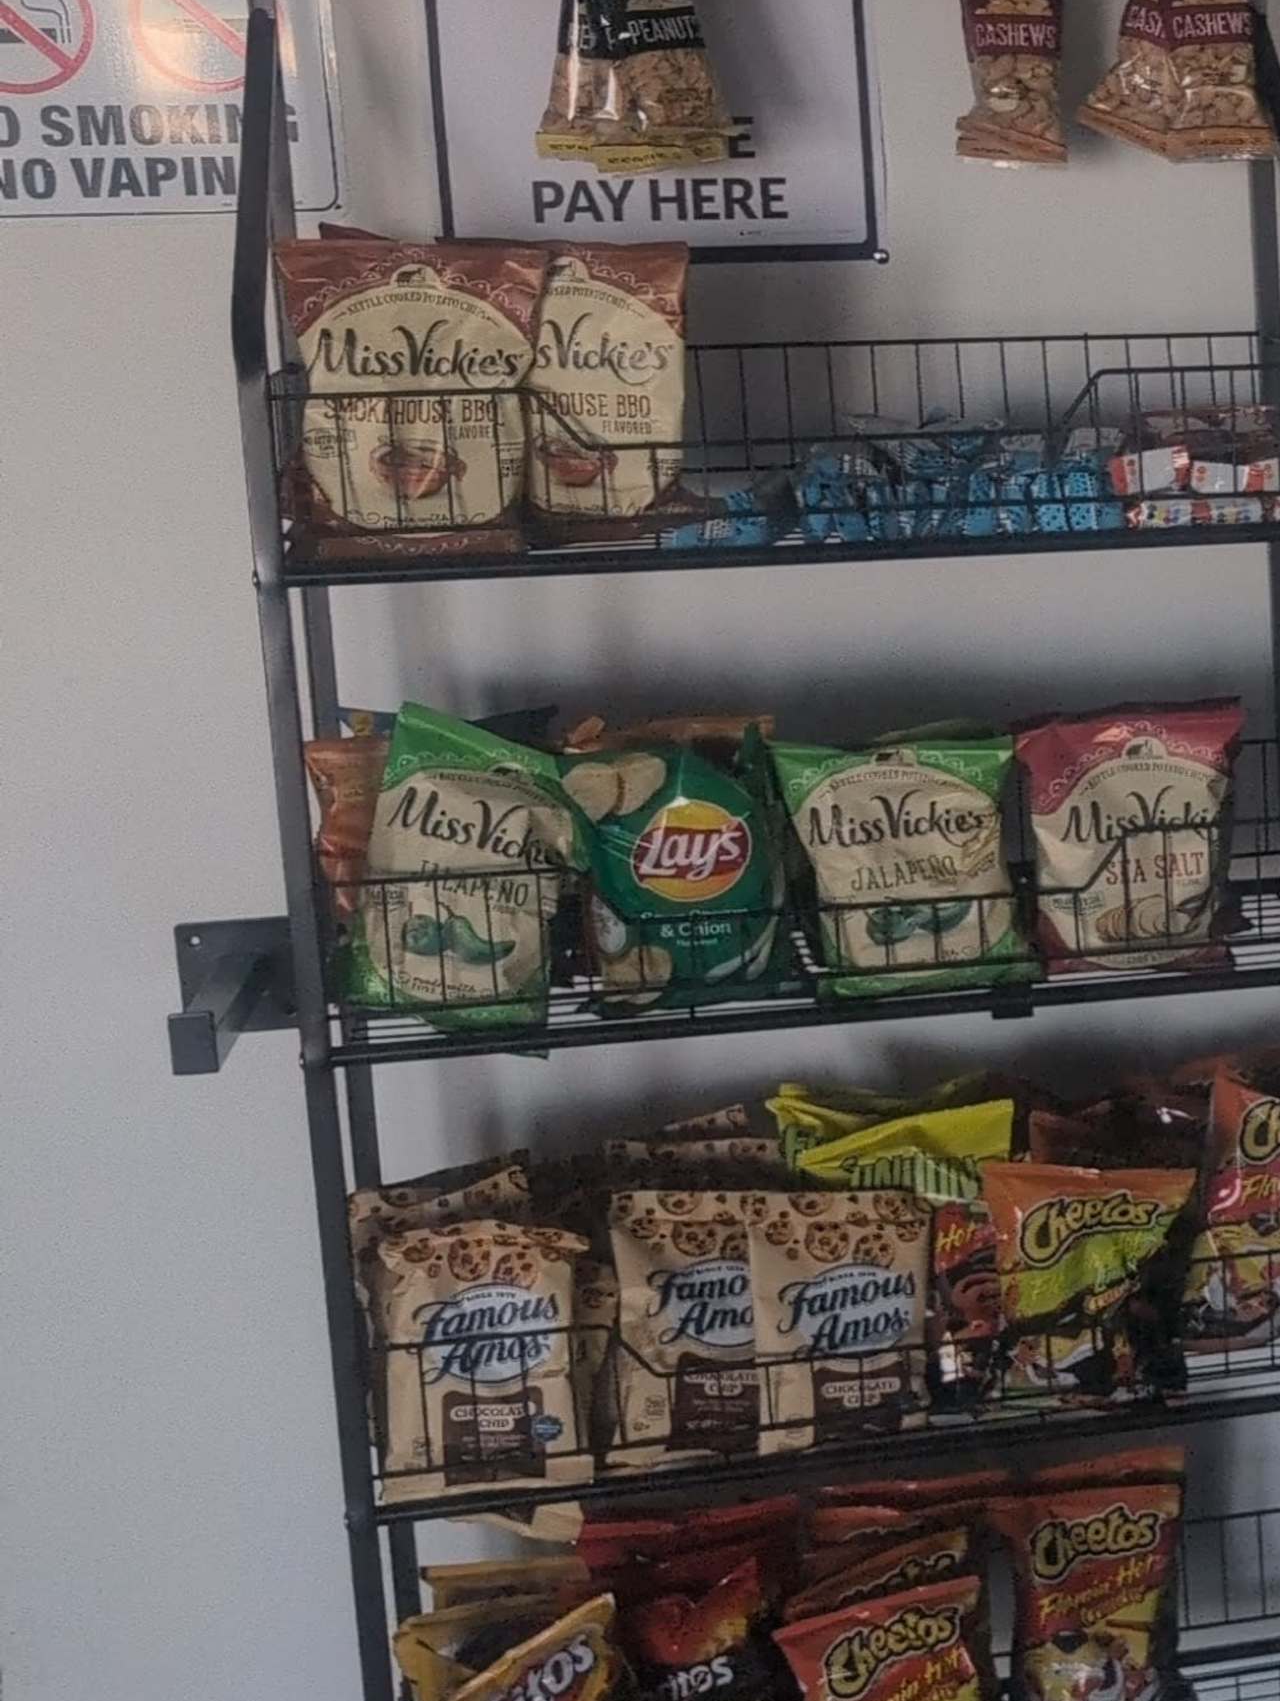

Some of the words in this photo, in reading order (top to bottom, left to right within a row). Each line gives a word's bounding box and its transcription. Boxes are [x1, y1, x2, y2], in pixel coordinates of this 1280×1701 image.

[629, 15, 694, 46] PEANUT
[975, 23, 1056, 49] CASHEWS
[70, 156, 237, 198] VAPIN
[531, 179, 635, 224] PAY
[651, 176, 789, 221] HERE
[307, 327, 405, 378] Miss
[392, 318, 519, 389] Vickie's
[542, 311, 669, 387] Vickie's
[616, 394, 651, 419] BBQ
[388, 785, 475, 845] Miss
[809, 803, 885, 849] Miss
[869, 788, 986, 848] Vickie's
[638, 823, 744, 881] Lay's
[1105, 858, 1148, 886] SA
[660, 924, 674, 938] &
[1020, 1192, 1160, 1267] Cheetos
[646, 1269, 749, 1318] Famo
[777, 1270, 916, 1334] Famous
[412, 1292, 560, 1354] Famous
[658, 1300, 755, 1345] Amo
[794, 1307, 907, 1357] Amos
[423, 1335, 547, 1385] Amos
[1030, 1505, 1160, 1580] Cheetos
[824, 1606, 959, 1700] Cheetos
